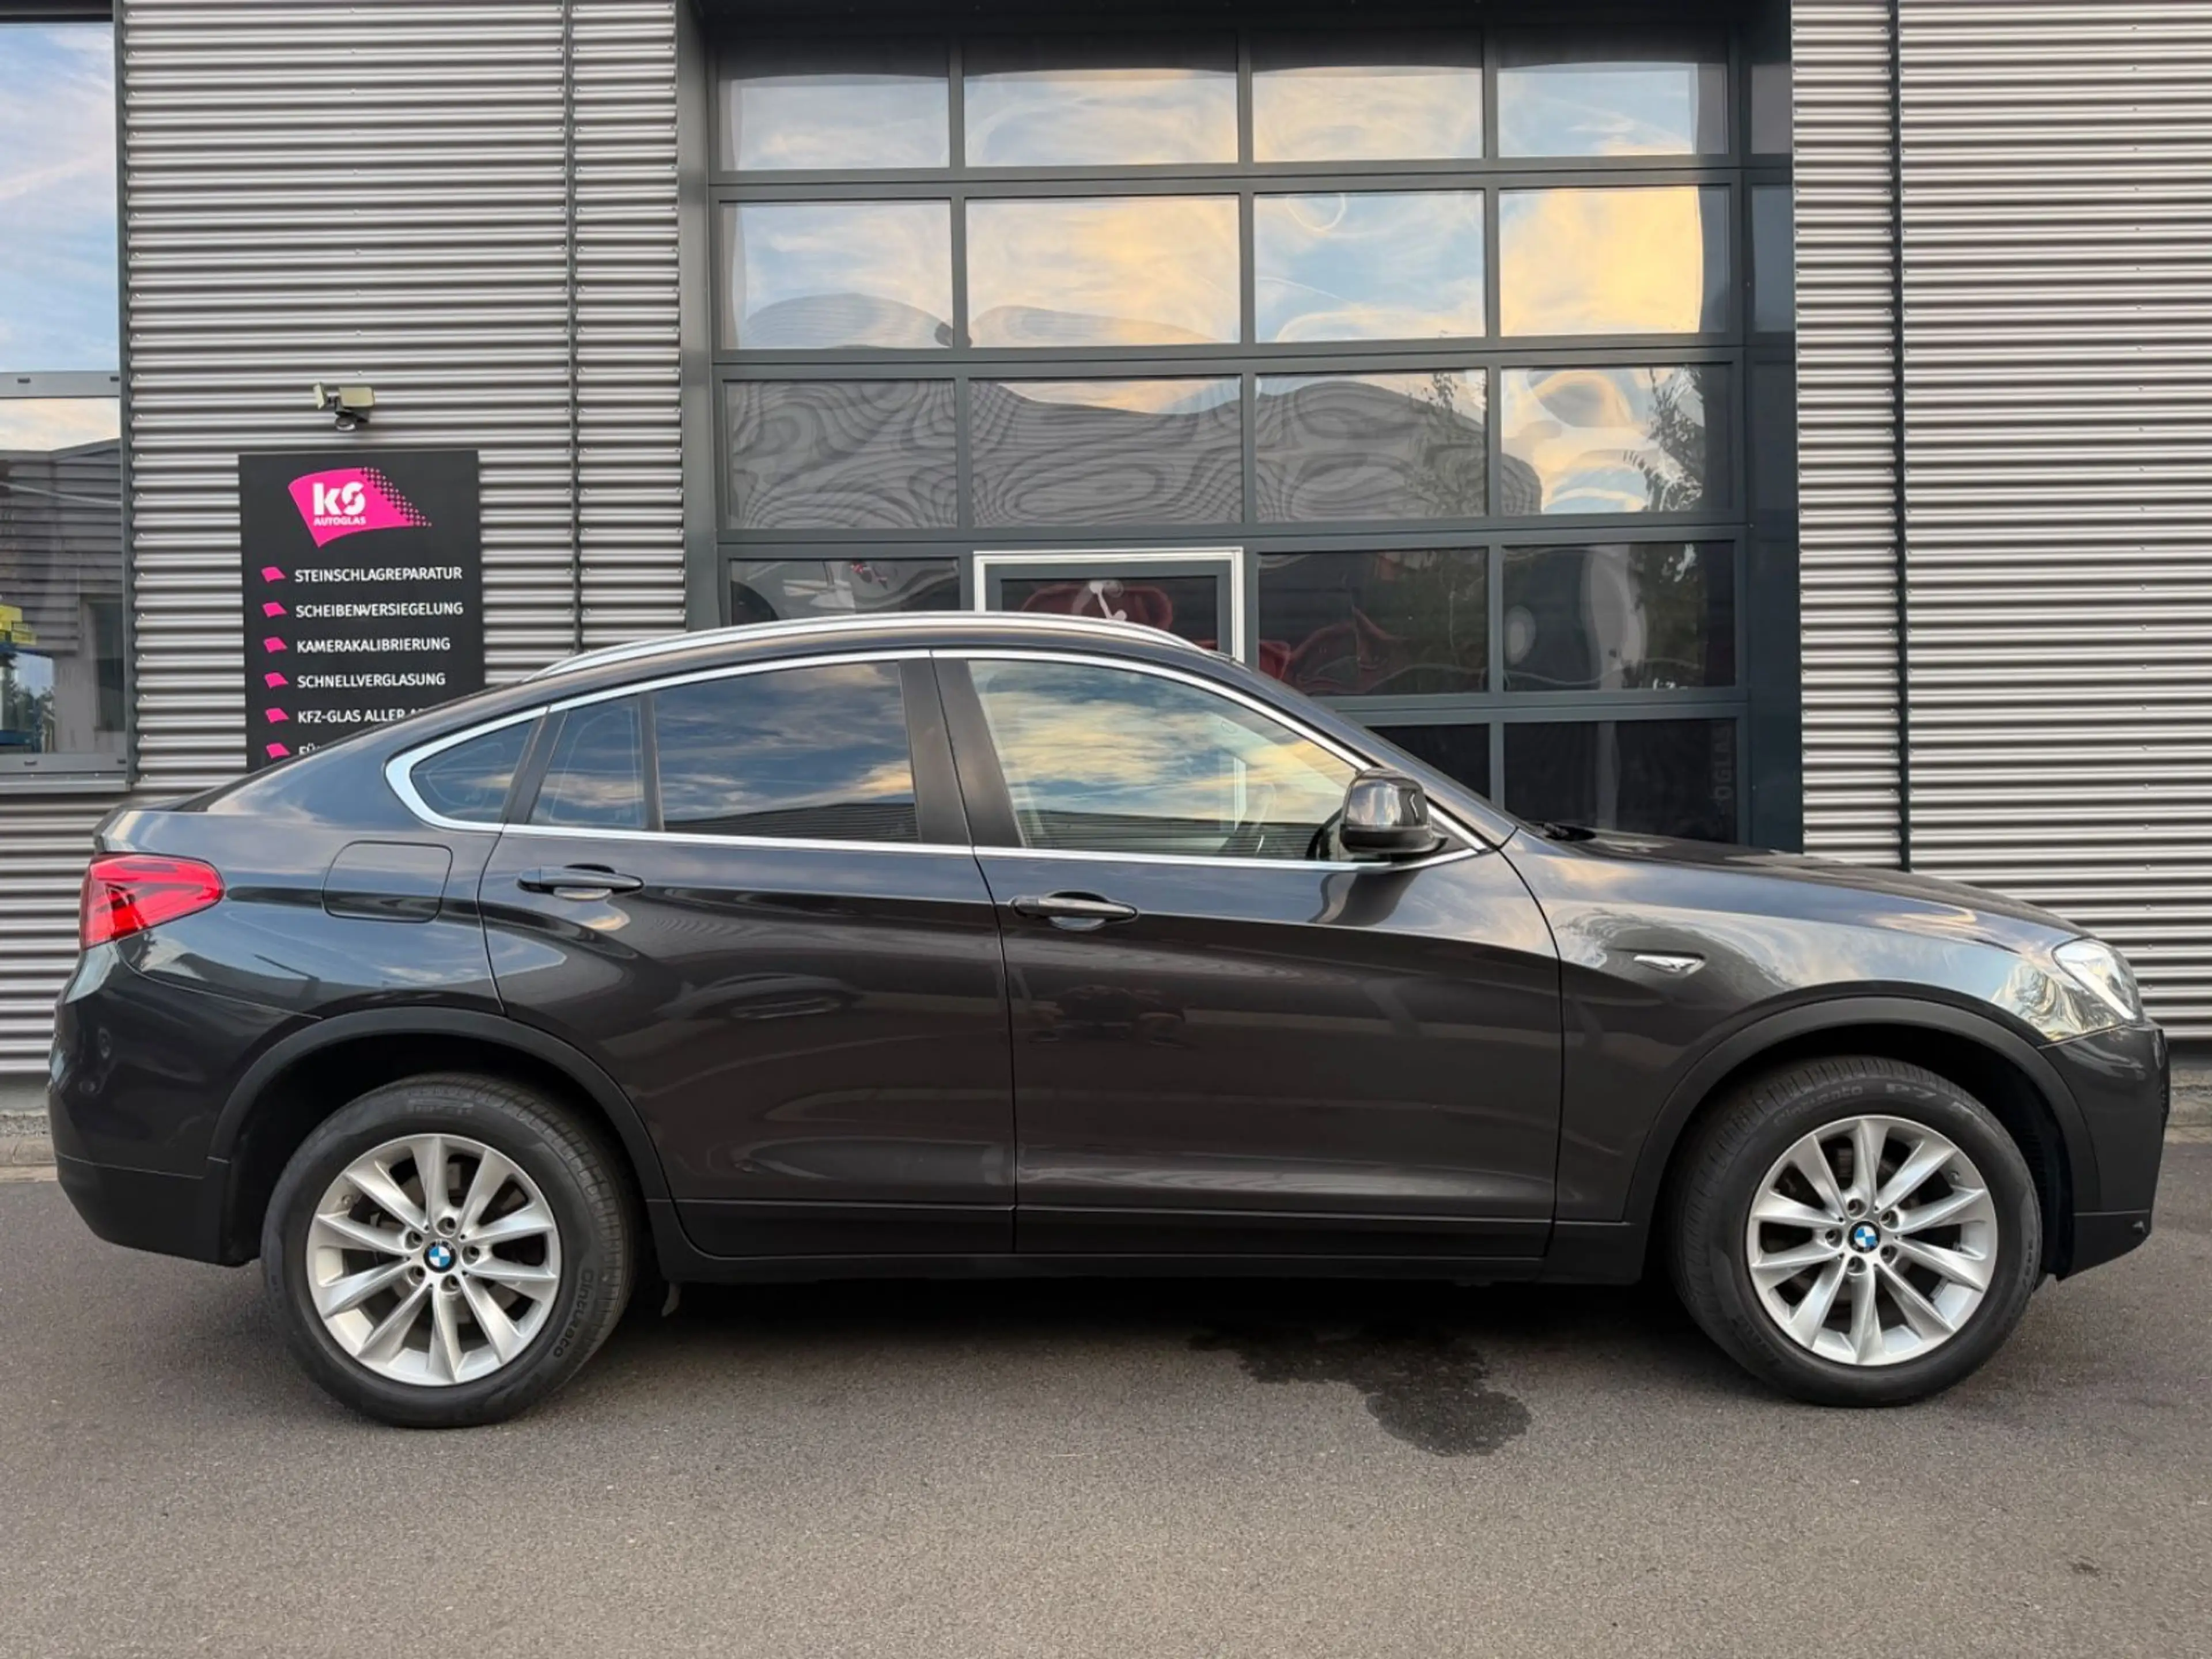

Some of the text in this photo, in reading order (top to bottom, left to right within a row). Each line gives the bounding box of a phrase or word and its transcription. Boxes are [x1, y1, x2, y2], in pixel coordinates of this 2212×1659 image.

[313, 516, 366, 526] AUTOGLAS
[294, 566, 463, 582] STEINSCHLAGREPARATUR
[296, 602, 463, 618] SCHEIBENVERSIEGELUNG
[297, 637, 450, 653] KAMERAKALIBRIERUNG
[297, 672, 446, 688] SCHNELLVERGLASUNG
[298, 709, 361, 724] KFZ-GLAS
[364, 708, 405, 722] ALLER
[298, 742, 321, 756] FÜ
